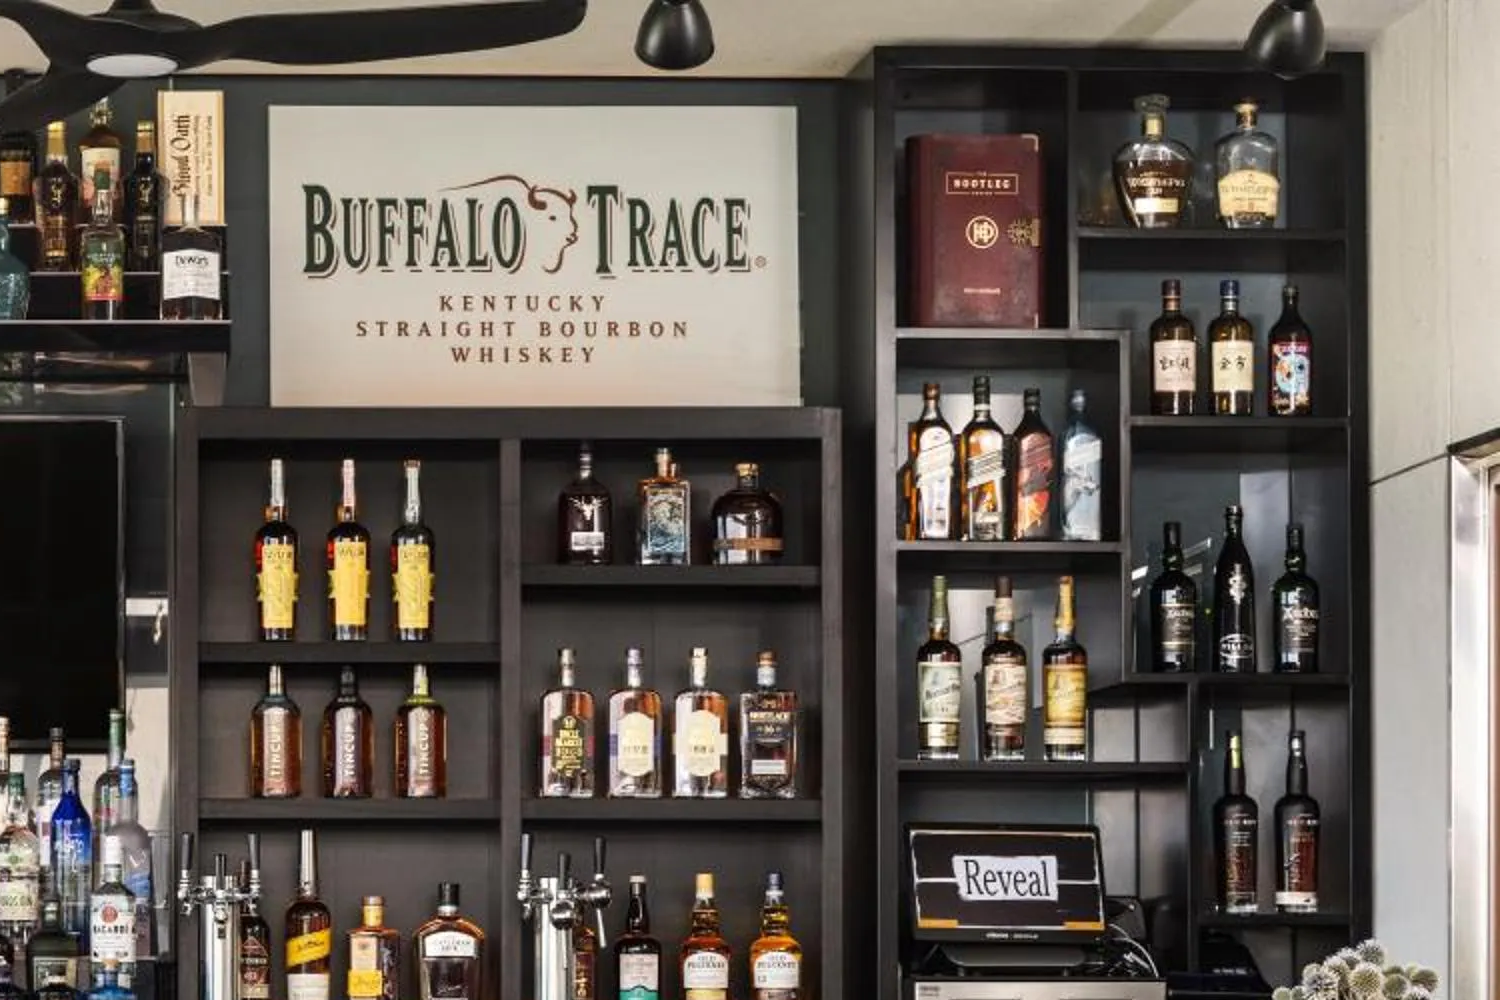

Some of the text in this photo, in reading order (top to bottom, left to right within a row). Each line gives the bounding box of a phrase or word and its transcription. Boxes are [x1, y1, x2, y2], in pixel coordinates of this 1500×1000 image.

[953, 178, 1011, 190] BOOTLEG
[301, 183, 753, 279] BUFFALO TRACE
[439, 294, 605, 313] KENTUCKY
[356, 320, 688, 338] STRAIGHT BOURBON
[450, 346, 596, 364] WHISKEY
[269, 721, 282, 778] TINCUP
[344, 722, 356, 778] TINCUP
[418, 722, 430, 778] TINCUP
[963, 858, 1052, 898] Reveal
